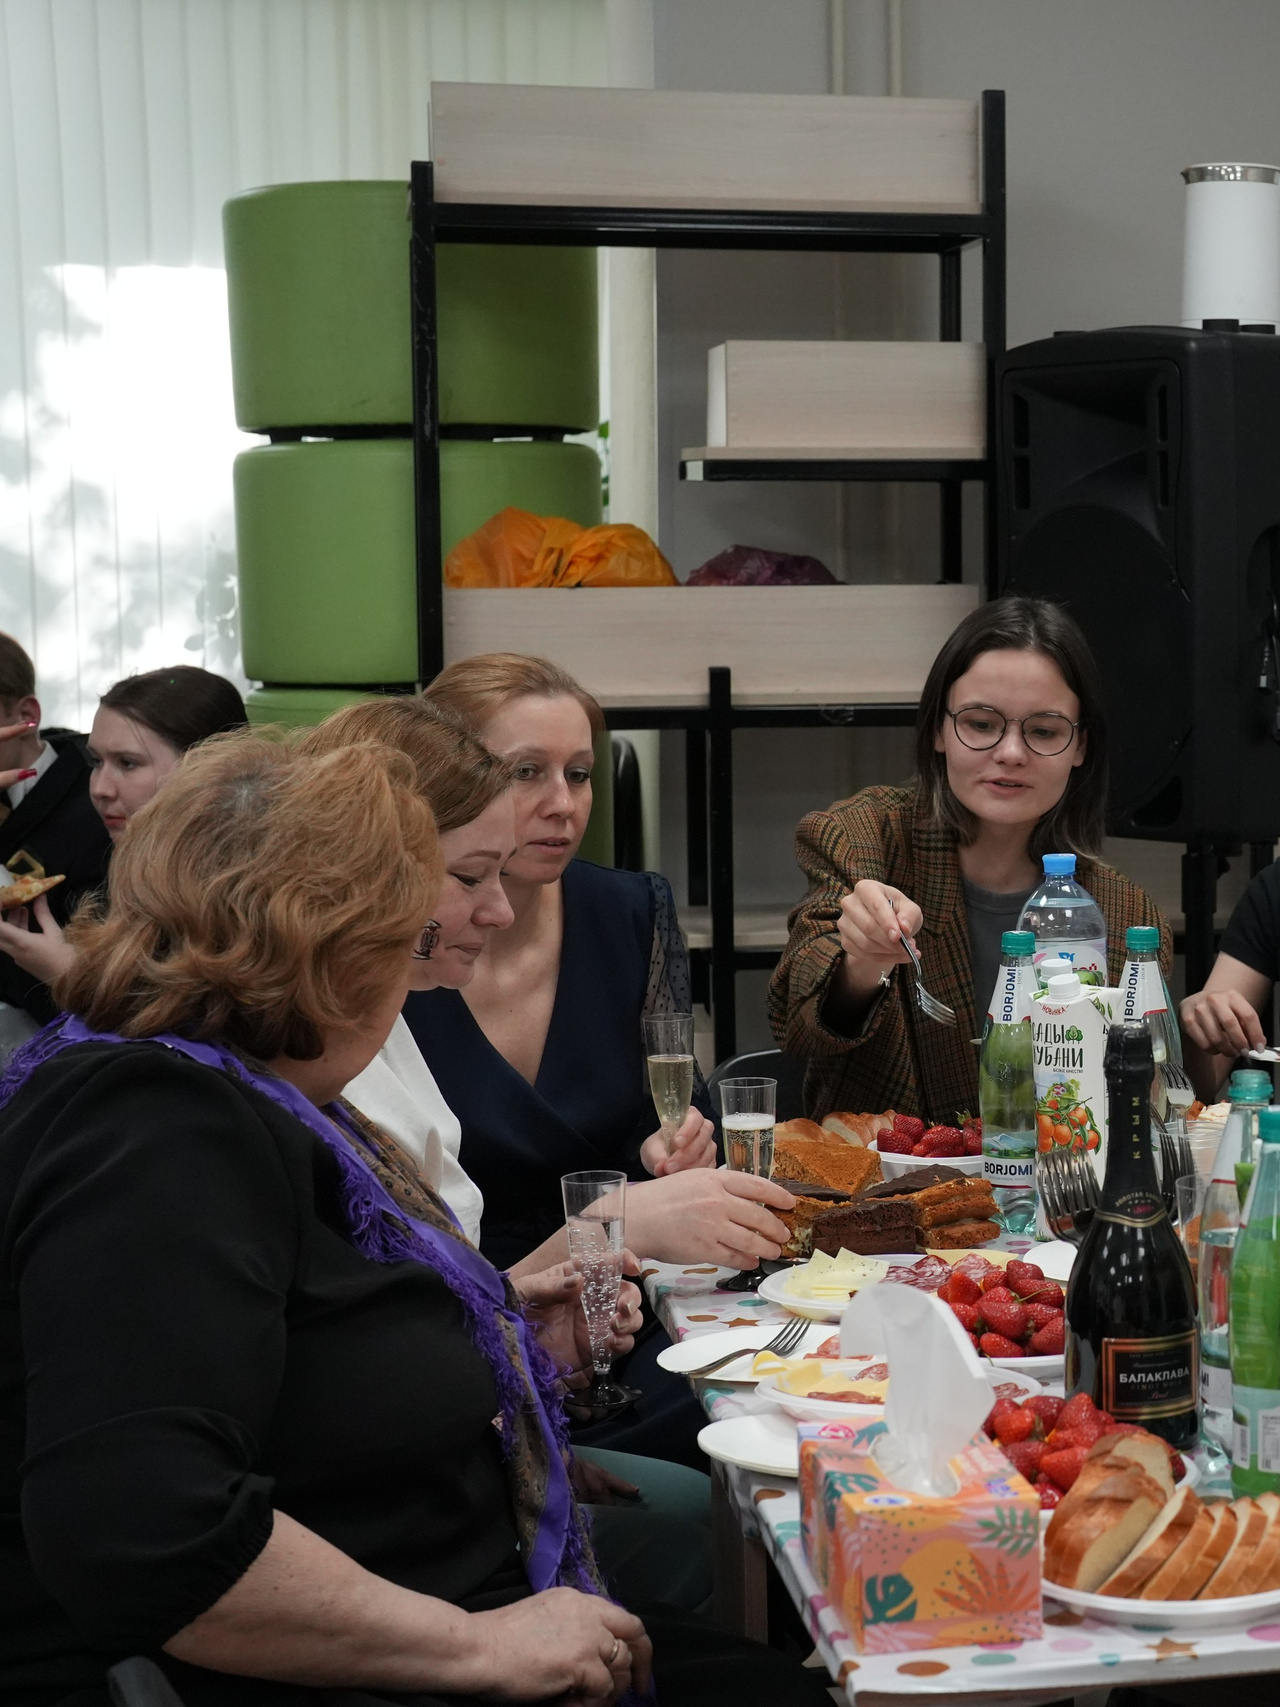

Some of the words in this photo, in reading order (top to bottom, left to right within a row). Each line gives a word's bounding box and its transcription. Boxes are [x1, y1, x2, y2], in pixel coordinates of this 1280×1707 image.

[1003, 968, 1017, 1022] BORJOMI
[1125, 963, 1140, 1016] BORJOMI
[1132, 1096, 1141, 1159] КРЫМ
[984, 1162, 1033, 1176] BORJOMI
[1119, 1366, 1190, 1384] БАЛАКЛАВА
